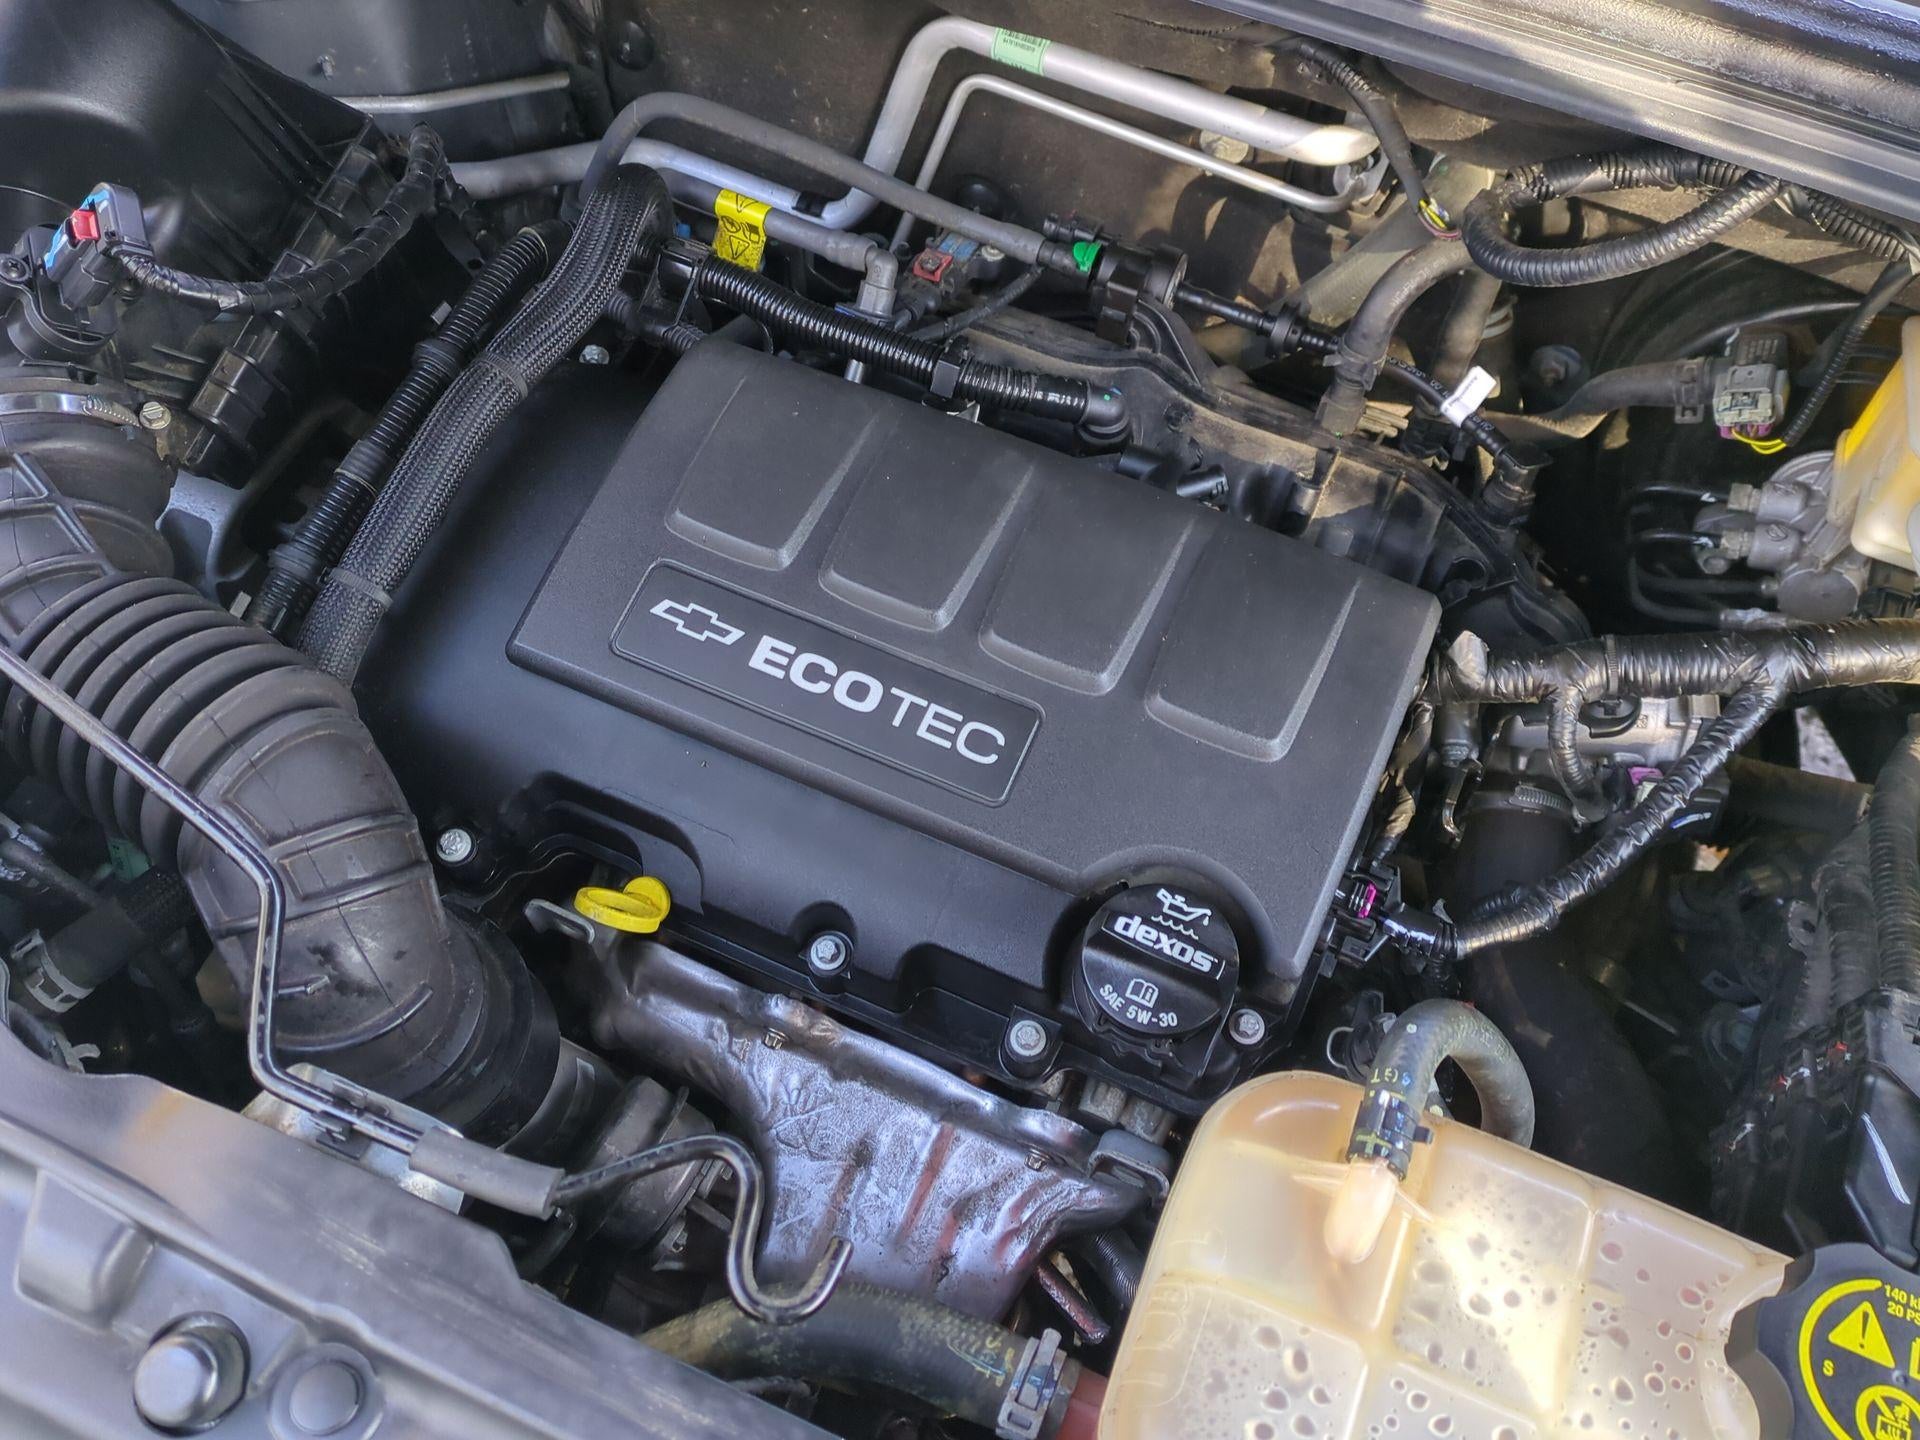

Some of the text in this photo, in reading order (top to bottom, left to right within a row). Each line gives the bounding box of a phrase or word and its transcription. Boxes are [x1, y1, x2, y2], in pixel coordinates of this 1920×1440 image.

[748, 635, 1005, 765] ECOTEC
[1113, 915, 1214, 973] dexos
[1100, 983, 1178, 1028] SAE 5W-30
[1884, 1284, 1908, 1304] 140
[1887, 1301, 1904, 1318] 20
